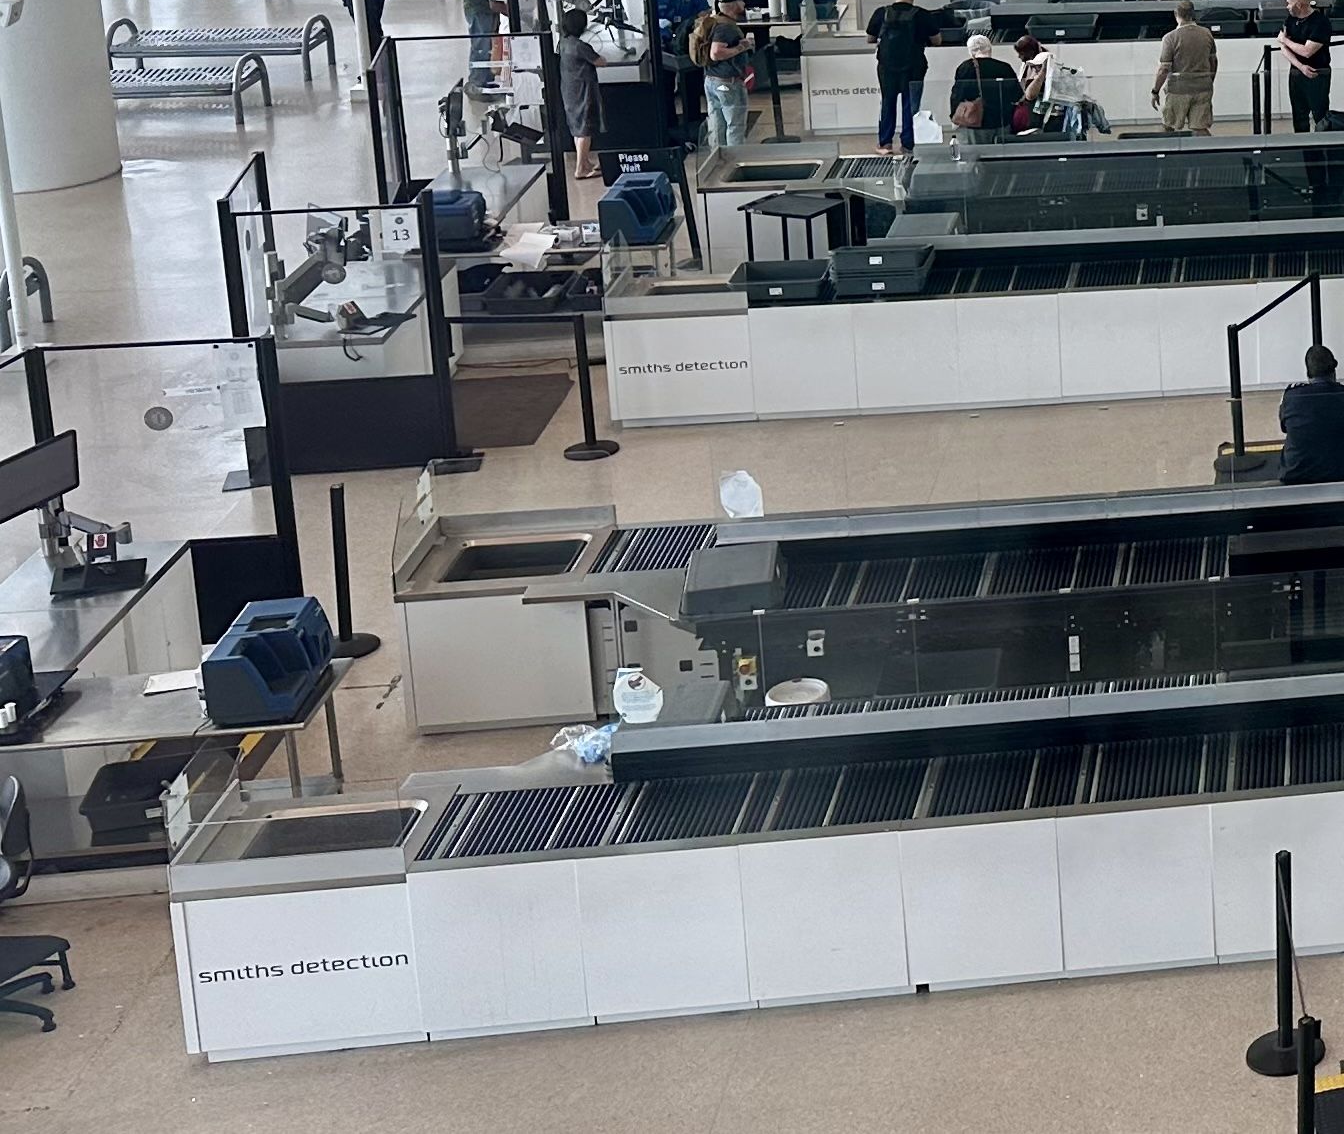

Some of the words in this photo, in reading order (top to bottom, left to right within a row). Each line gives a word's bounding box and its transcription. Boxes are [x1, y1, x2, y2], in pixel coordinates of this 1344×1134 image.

[811, 87, 850, 97] smiths
[618, 153, 649, 163] Please
[620, 163, 641, 173] Wait
[392, 229, 410, 241] 13
[619, 362, 672, 375] smiths
[675, 360, 748, 372] detection
[198, 965, 284, 983] smiths
[291, 953, 409, 975] detection
